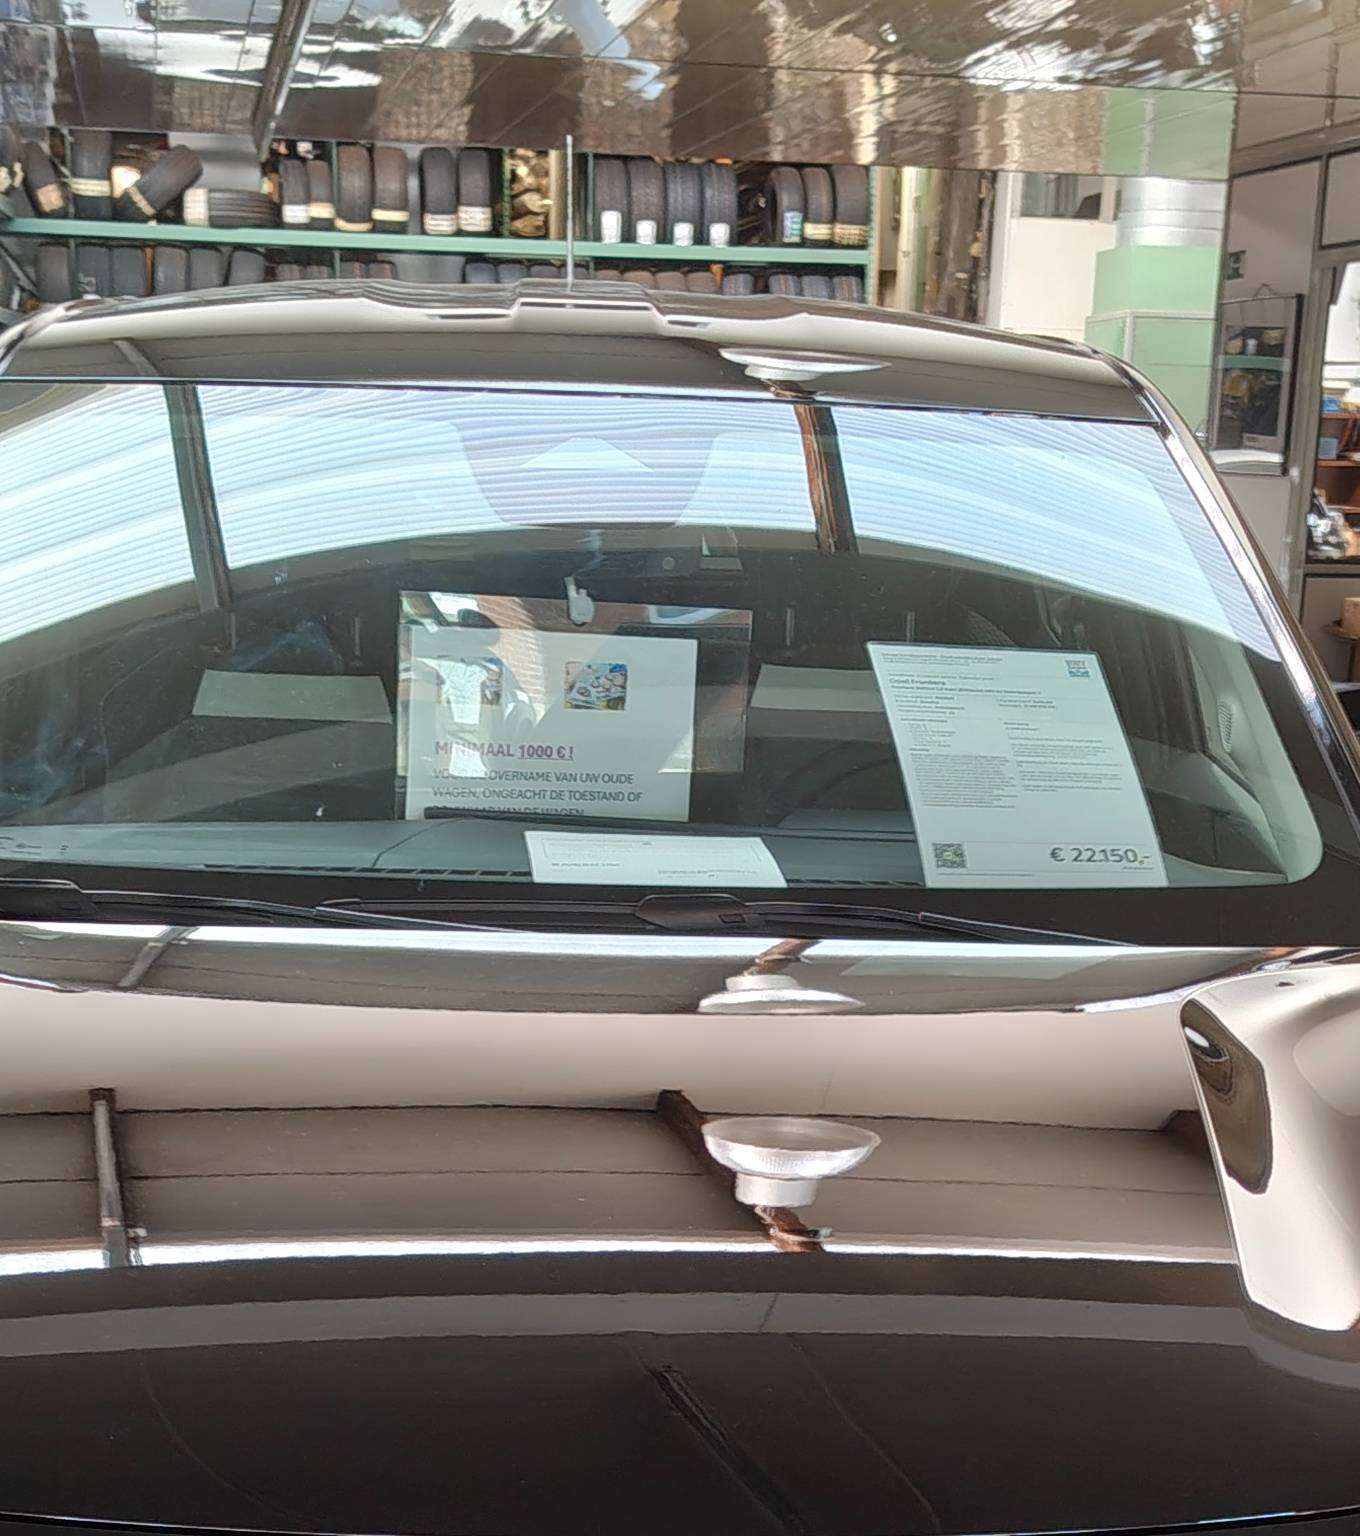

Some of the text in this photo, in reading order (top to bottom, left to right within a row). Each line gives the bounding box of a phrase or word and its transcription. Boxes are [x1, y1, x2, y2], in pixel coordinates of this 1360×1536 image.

[436, 741, 515, 757] MIMAAL
[518, 744, 554, 758] 1000
[489, 769, 553, 782] OVERNAME
[554, 771, 578, 783] VAN
[580, 772, 601, 784] UW
[601, 772, 635, 785] OUDE
[482, 787, 547, 801] ONGEACHT
[549, 789, 565, 801] DE
[568, 789, 625, 802] TOESTAND
[627, 790, 644, 802] OF
[1050, 847, 1066, 862] €
